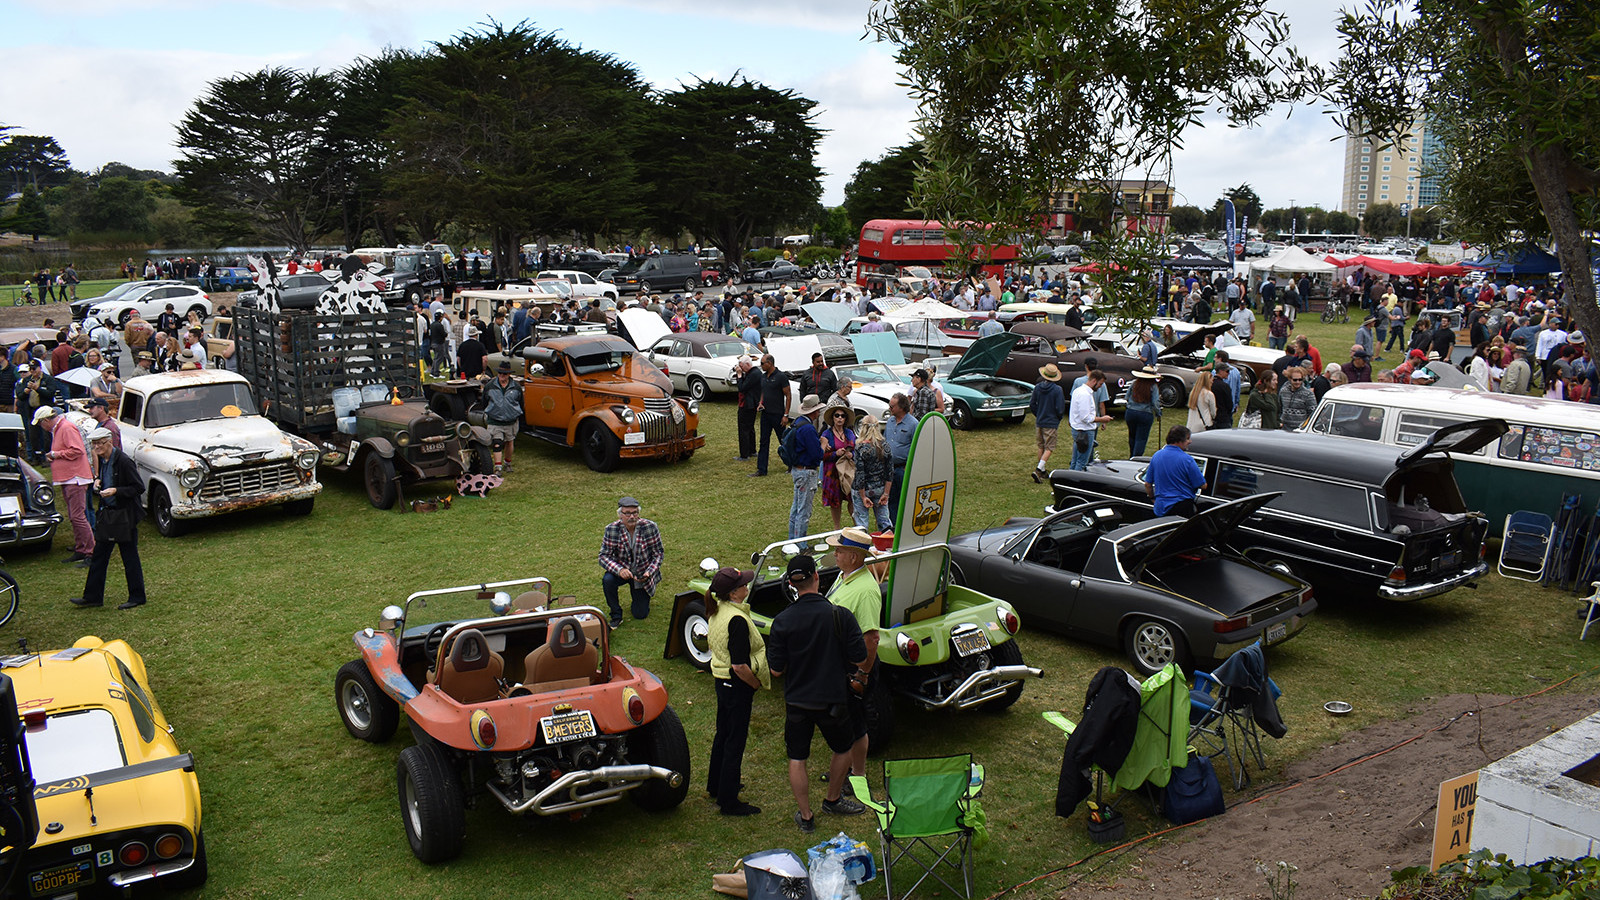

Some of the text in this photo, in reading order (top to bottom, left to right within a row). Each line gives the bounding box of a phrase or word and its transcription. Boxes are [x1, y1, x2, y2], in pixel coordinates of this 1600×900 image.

[1451, 811, 1465, 828] HAS
[1449, 829, 1460, 850] A
[73, 845, 91, 854] GT1
[99, 851, 112, 865] 8
[44, 865, 78, 877] CALIFORNIA
